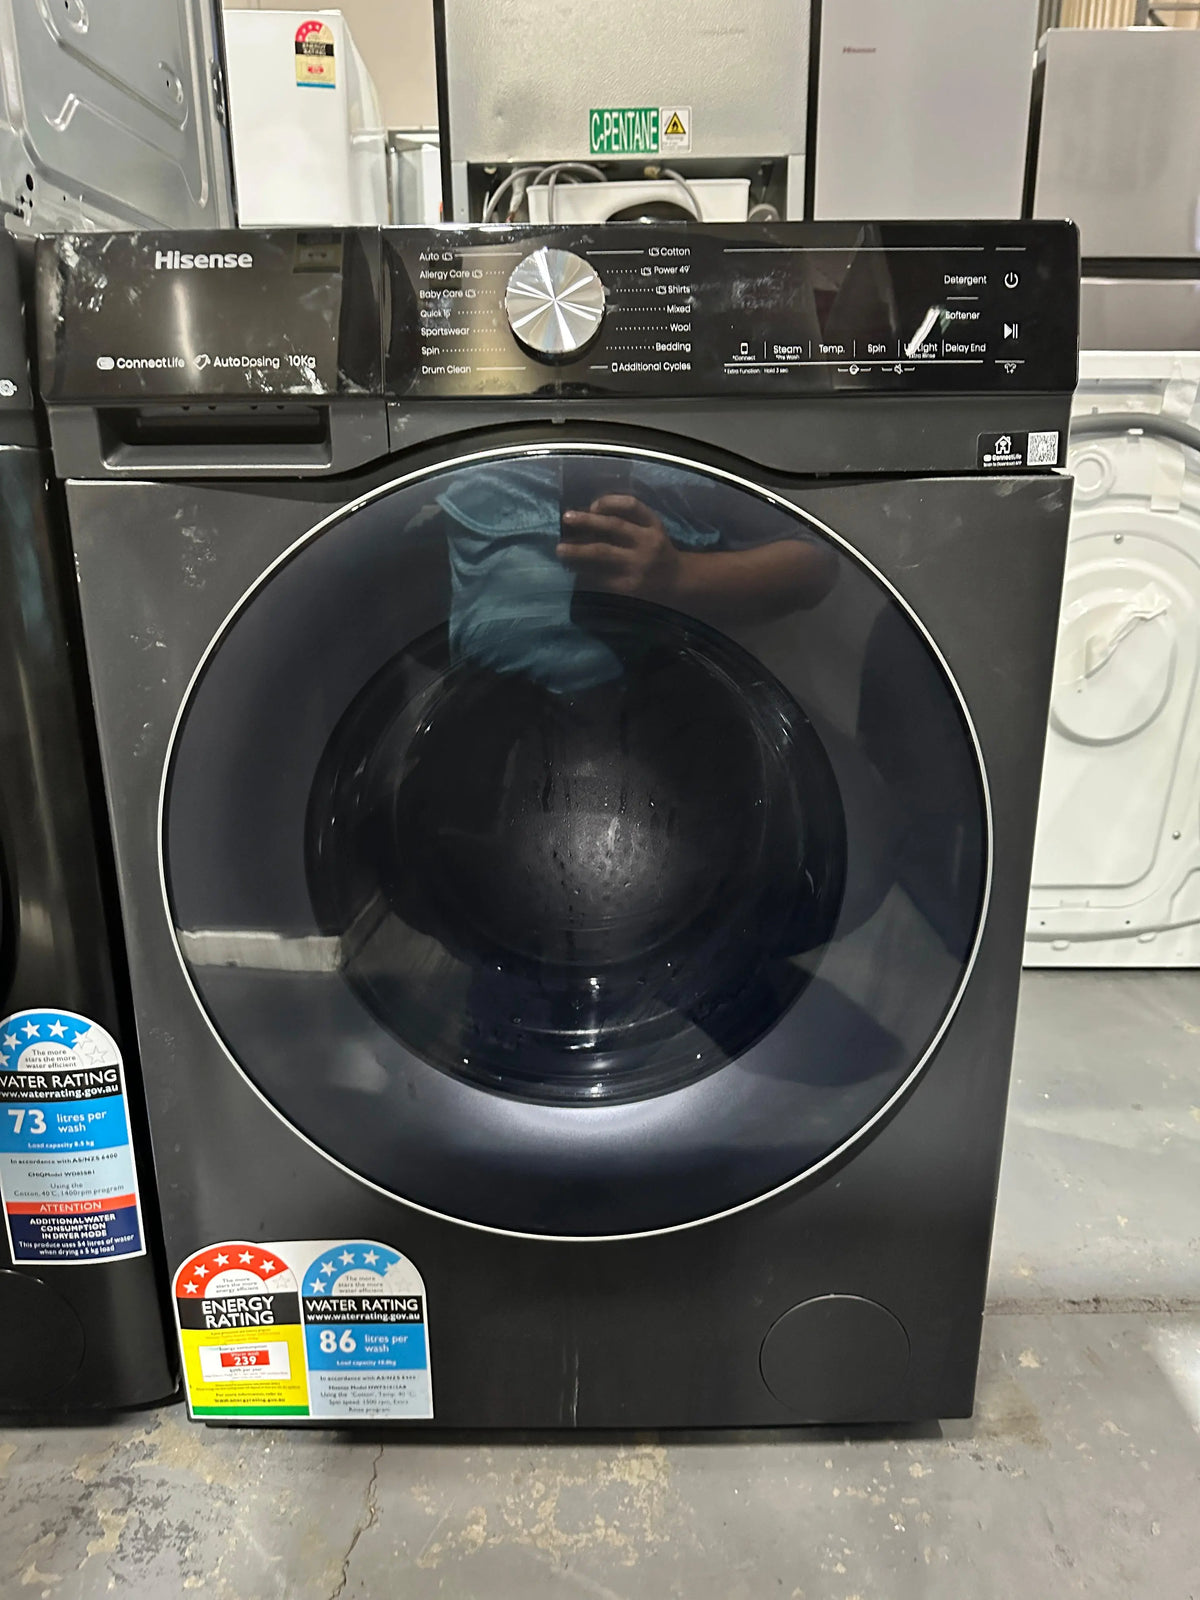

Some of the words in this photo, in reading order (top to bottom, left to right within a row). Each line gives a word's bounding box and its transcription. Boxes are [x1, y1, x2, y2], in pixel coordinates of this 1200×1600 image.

[591, 111, 657, 151] C-PENTANE
[419, 252, 440, 261] Auto
[660, 247, 691, 256] Cotton
[155, 250, 253, 270] Hisense
[419, 270, 448, 280] Allergy
[449, 269, 470, 278] Care
[653, 266, 678, 275] Power
[944, 274, 987, 286] Detergent
[419, 290, 441, 300] Baby
[442, 289, 463, 298] Care
[668, 285, 691, 294] Shirts
[420, 310, 442, 318] Quick
[667, 305, 691, 313] Mixed
[945, 311, 980, 320] Softener
[420, 327, 470, 337] Sportswear
[670, 323, 691, 331] Wool
[421, 346, 440, 356] Spin
[656, 343, 692, 353] Bedding
[773, 345, 803, 355] Steam
[867, 343, 886, 354] Spin
[945, 343, 969, 354] Delay
[971, 343, 986, 352] End
[116, 357, 185, 369] ConnectLife
[288, 354, 316, 368] 10Kg
[421, 366, 445, 375] Drum
[446, 366, 471, 375] Clean
[619, 363, 661, 372] Additional
[663, 362, 692, 373] Cycles
[52, 1069, 118, 1088] RATING
[7, 1109, 47, 1134] 73
[57, 1112, 85, 1123] litres
[87, 1110, 107, 1122] per
[57, 1122, 86, 1133] wash
[93, 1185, 125, 1195] program
[40, 1202, 102, 1212] ATTENTION
[30, 1217, 84, 1225] ADDITIONAL
[84, 1213, 116, 1222] WATER
[40, 1222, 106, 1232] CONSUMPTION
[42, 1232, 52, 1240] IN
[53, 1231, 80, 1240] DRYER
[80, 1230, 107, 1238] MODE
[115, 1235, 135, 1243] water
[202, 1296, 274, 1315] ENERGY
[305, 1299, 358, 1312] WATER
[362, 1298, 419, 1312] RATING
[206, 1311, 274, 1329] RATING
[307, 1312, 421, 1322] www.waterrating.gov.au
[320, 1329, 357, 1353] 86
[364, 1334, 390, 1343] litres
[391, 1334, 409, 1344] per
[364, 1344, 390, 1353] wash
[233, 1356, 257, 1366] 239
